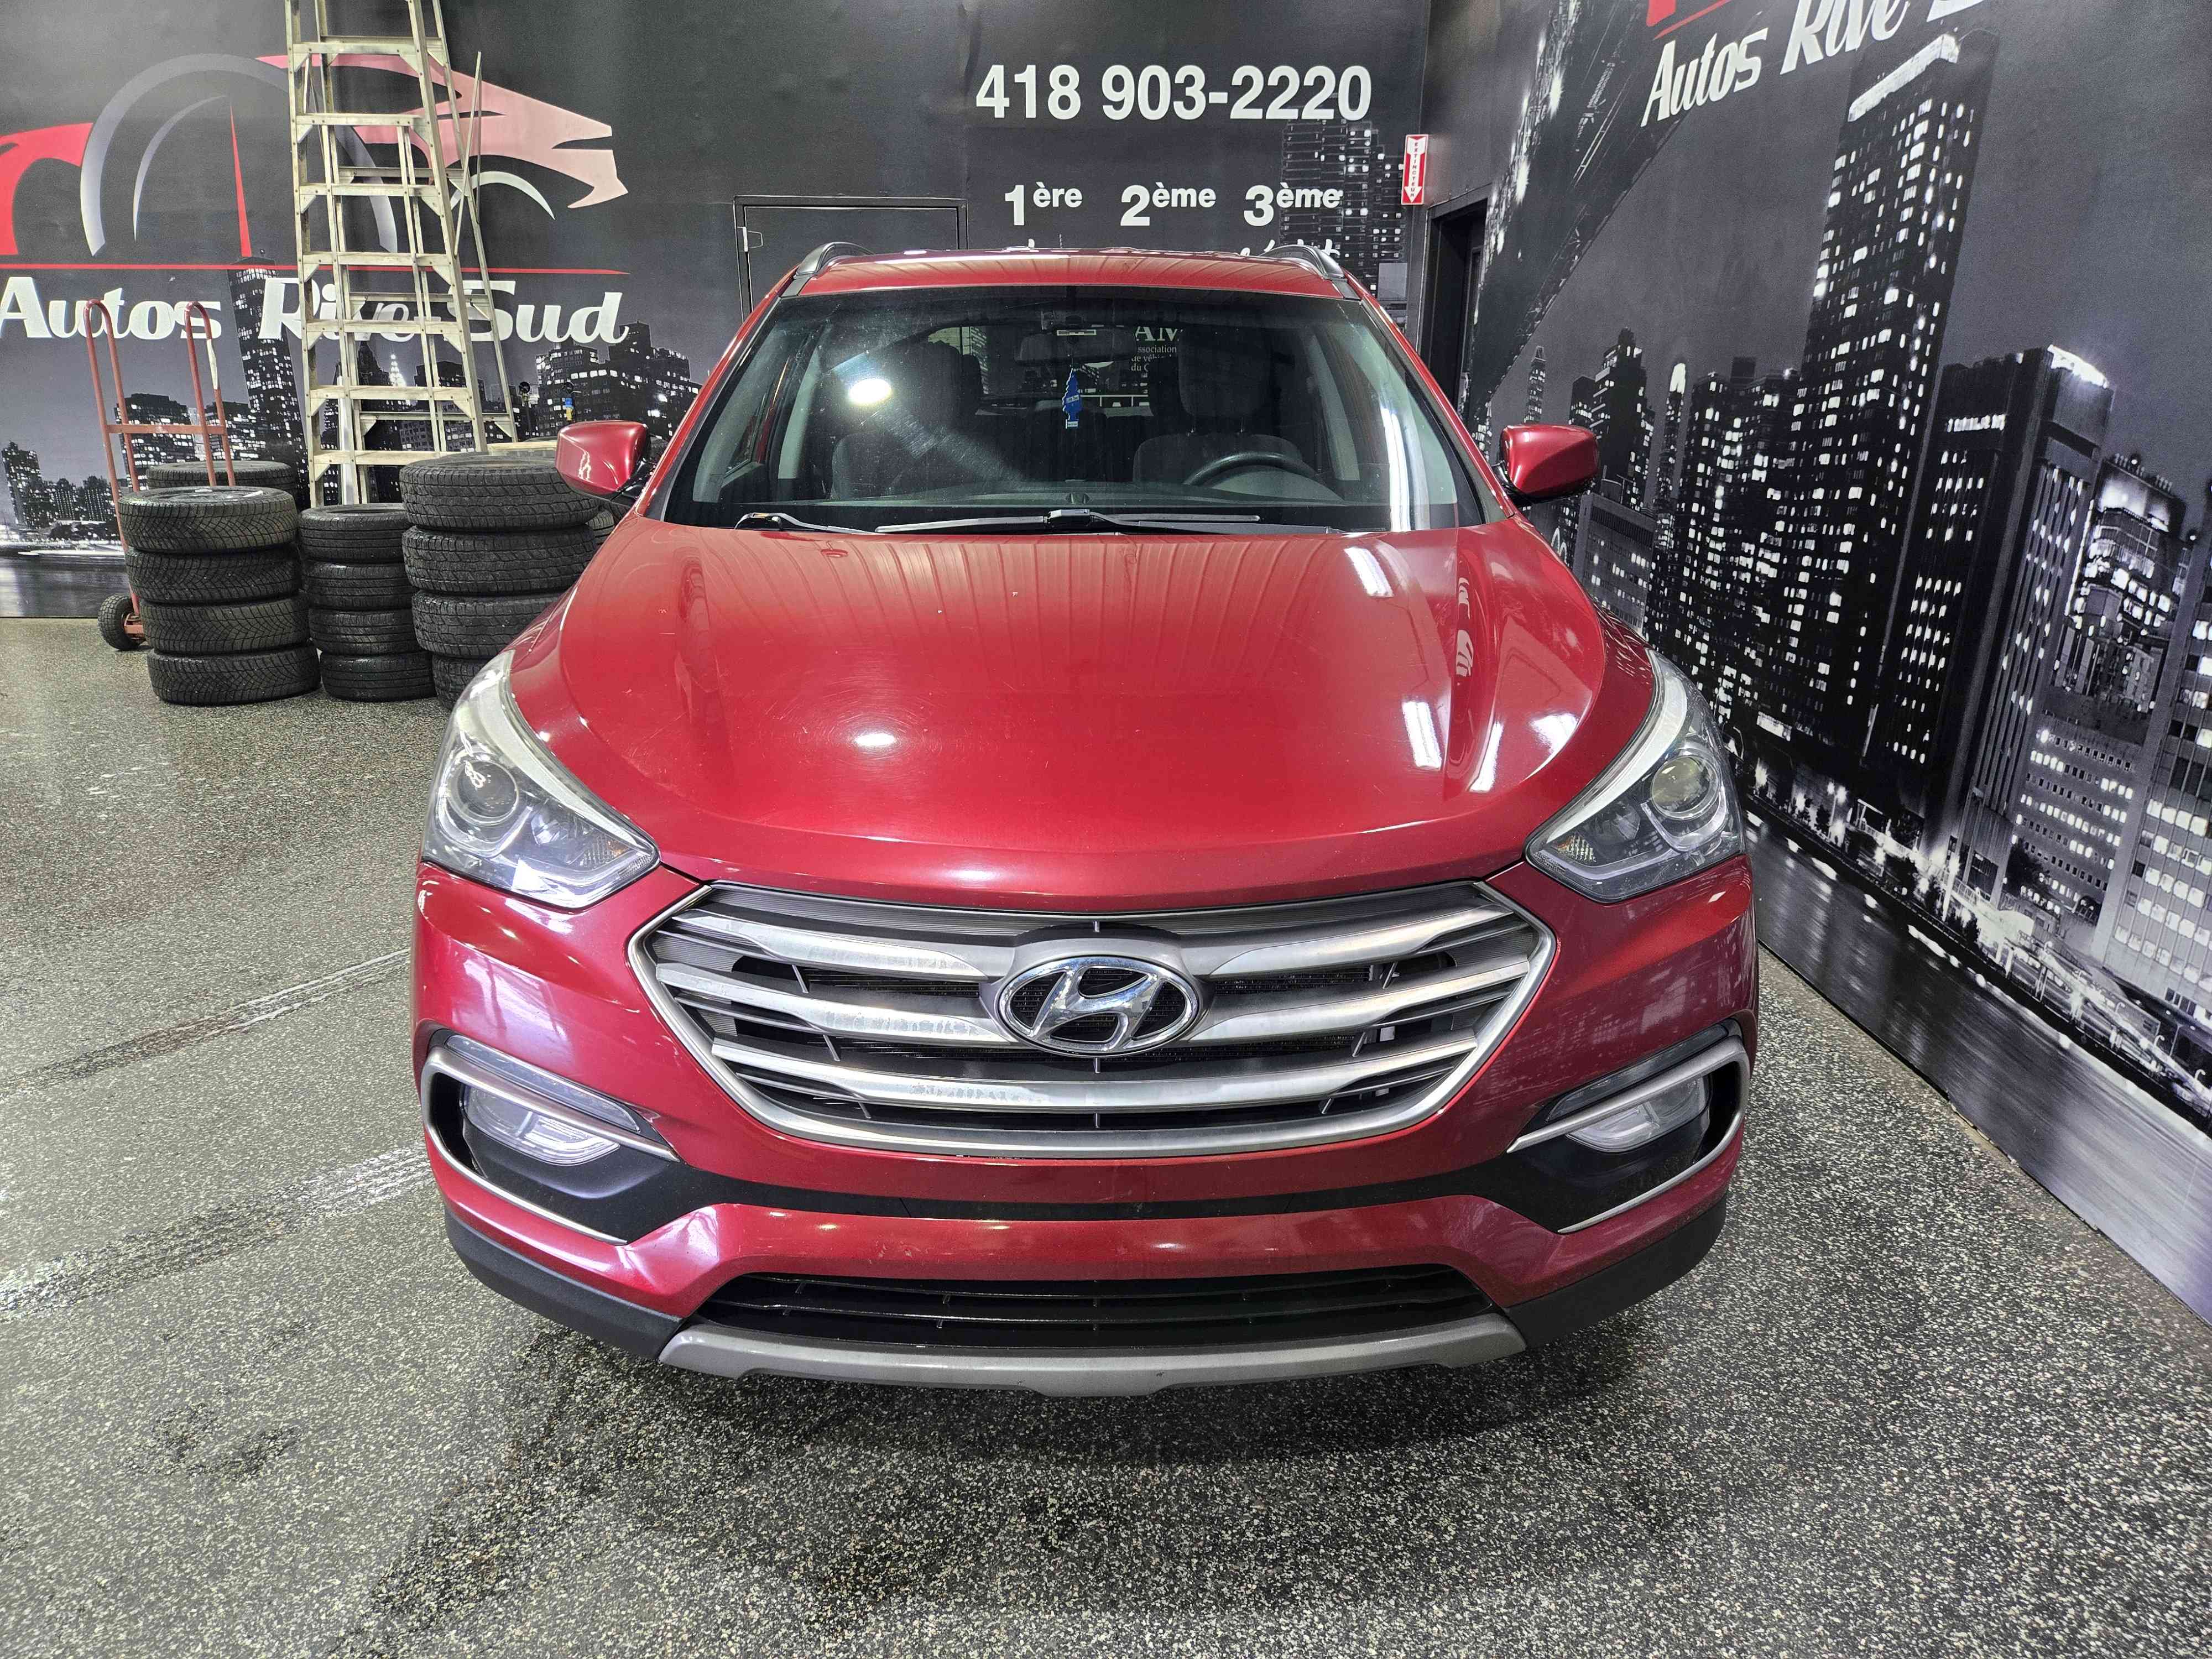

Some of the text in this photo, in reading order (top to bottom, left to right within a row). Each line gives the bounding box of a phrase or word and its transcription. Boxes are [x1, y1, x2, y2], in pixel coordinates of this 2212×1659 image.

[976, 65, 1371, 121] 418 903-2220
[1640, 27, 1769, 127] Autos
[1410, 142, 1418, 197] EXTINCTEUR
[1005, 181, 1344, 227] 1ère 2ème 3ème
[0, 276, 222, 340] Autos
[1138, 345, 1177, 353] ssociation
